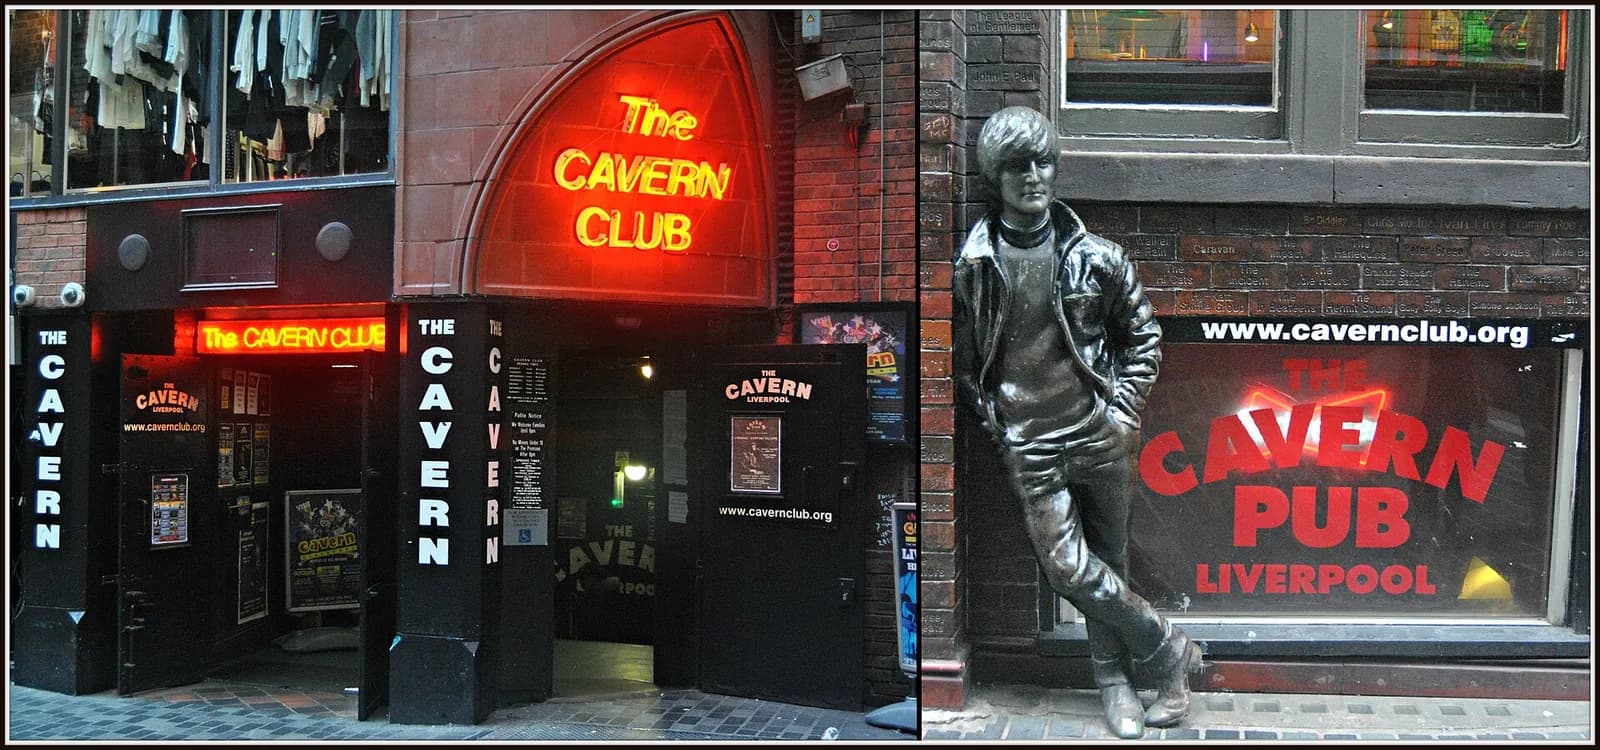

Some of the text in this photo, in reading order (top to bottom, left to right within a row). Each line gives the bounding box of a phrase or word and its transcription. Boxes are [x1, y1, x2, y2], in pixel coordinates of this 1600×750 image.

[973, 71, 1036, 82] John E Paul
[620, 95, 697, 140] The
[554, 148, 731, 200] CAVERN
[576, 206, 692, 251] CLUB
[1193, 244, 1236, 254] Caravan
[39, 330, 67, 346] THE
[203, 327, 239, 348] The
[244, 326, 328, 348] CAVERN
[419, 320, 455, 336] THE
[490, 320, 502, 336] THE
[1201, 319, 1529, 348] www.cavernclub.org
[1283, 359, 1369, 392] THE
[726, 378, 812, 400] CAVERN
[136, 390, 199, 412] CAVERN
[152, 406, 184, 414] LIVERPOOL
[124, 421, 206, 433] www.cavernclub.org
[36, 355, 66, 549] CAVERN
[418, 347, 454, 566] CAVERN
[486, 347, 502, 565] CAVERN
[1139, 403, 1505, 504] CAVERN
[719, 506, 832, 523] www.cavernclub.org
[1233, 485, 1410, 548] PUB
[605, 525, 633, 537] THE
[1196, 564, 1436, 594] LIVERPOOL
